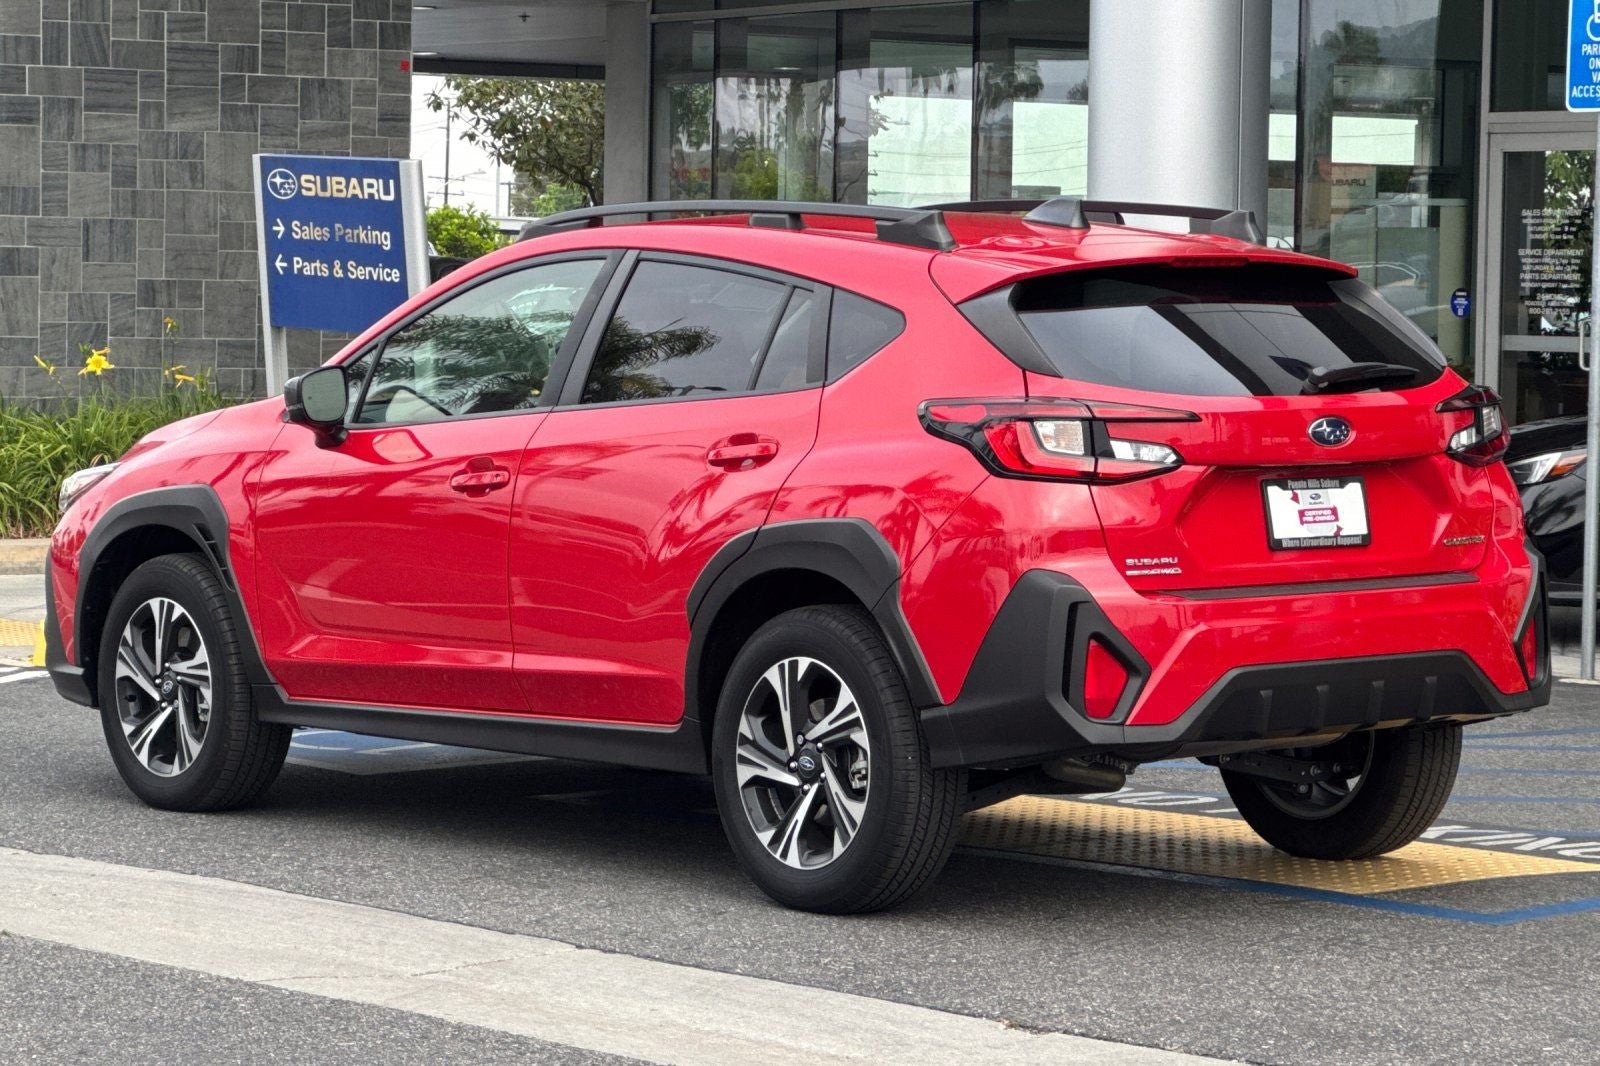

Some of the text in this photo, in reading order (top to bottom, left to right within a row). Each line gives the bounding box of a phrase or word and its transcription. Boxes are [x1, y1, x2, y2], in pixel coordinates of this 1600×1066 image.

[1581, 43, 1600, 56] PAR
[300, 174, 395, 201] SUBARU
[291, 220, 391, 250] Sales Parking
[1518, 248, 1584, 256] SERVICE DEPARTMENT
[293, 256, 400, 283] Parts & Service
[1519, 272, 1582, 280] PARTS DEPARTMENT
[1125, 557, 1178, 566] SUBARU
